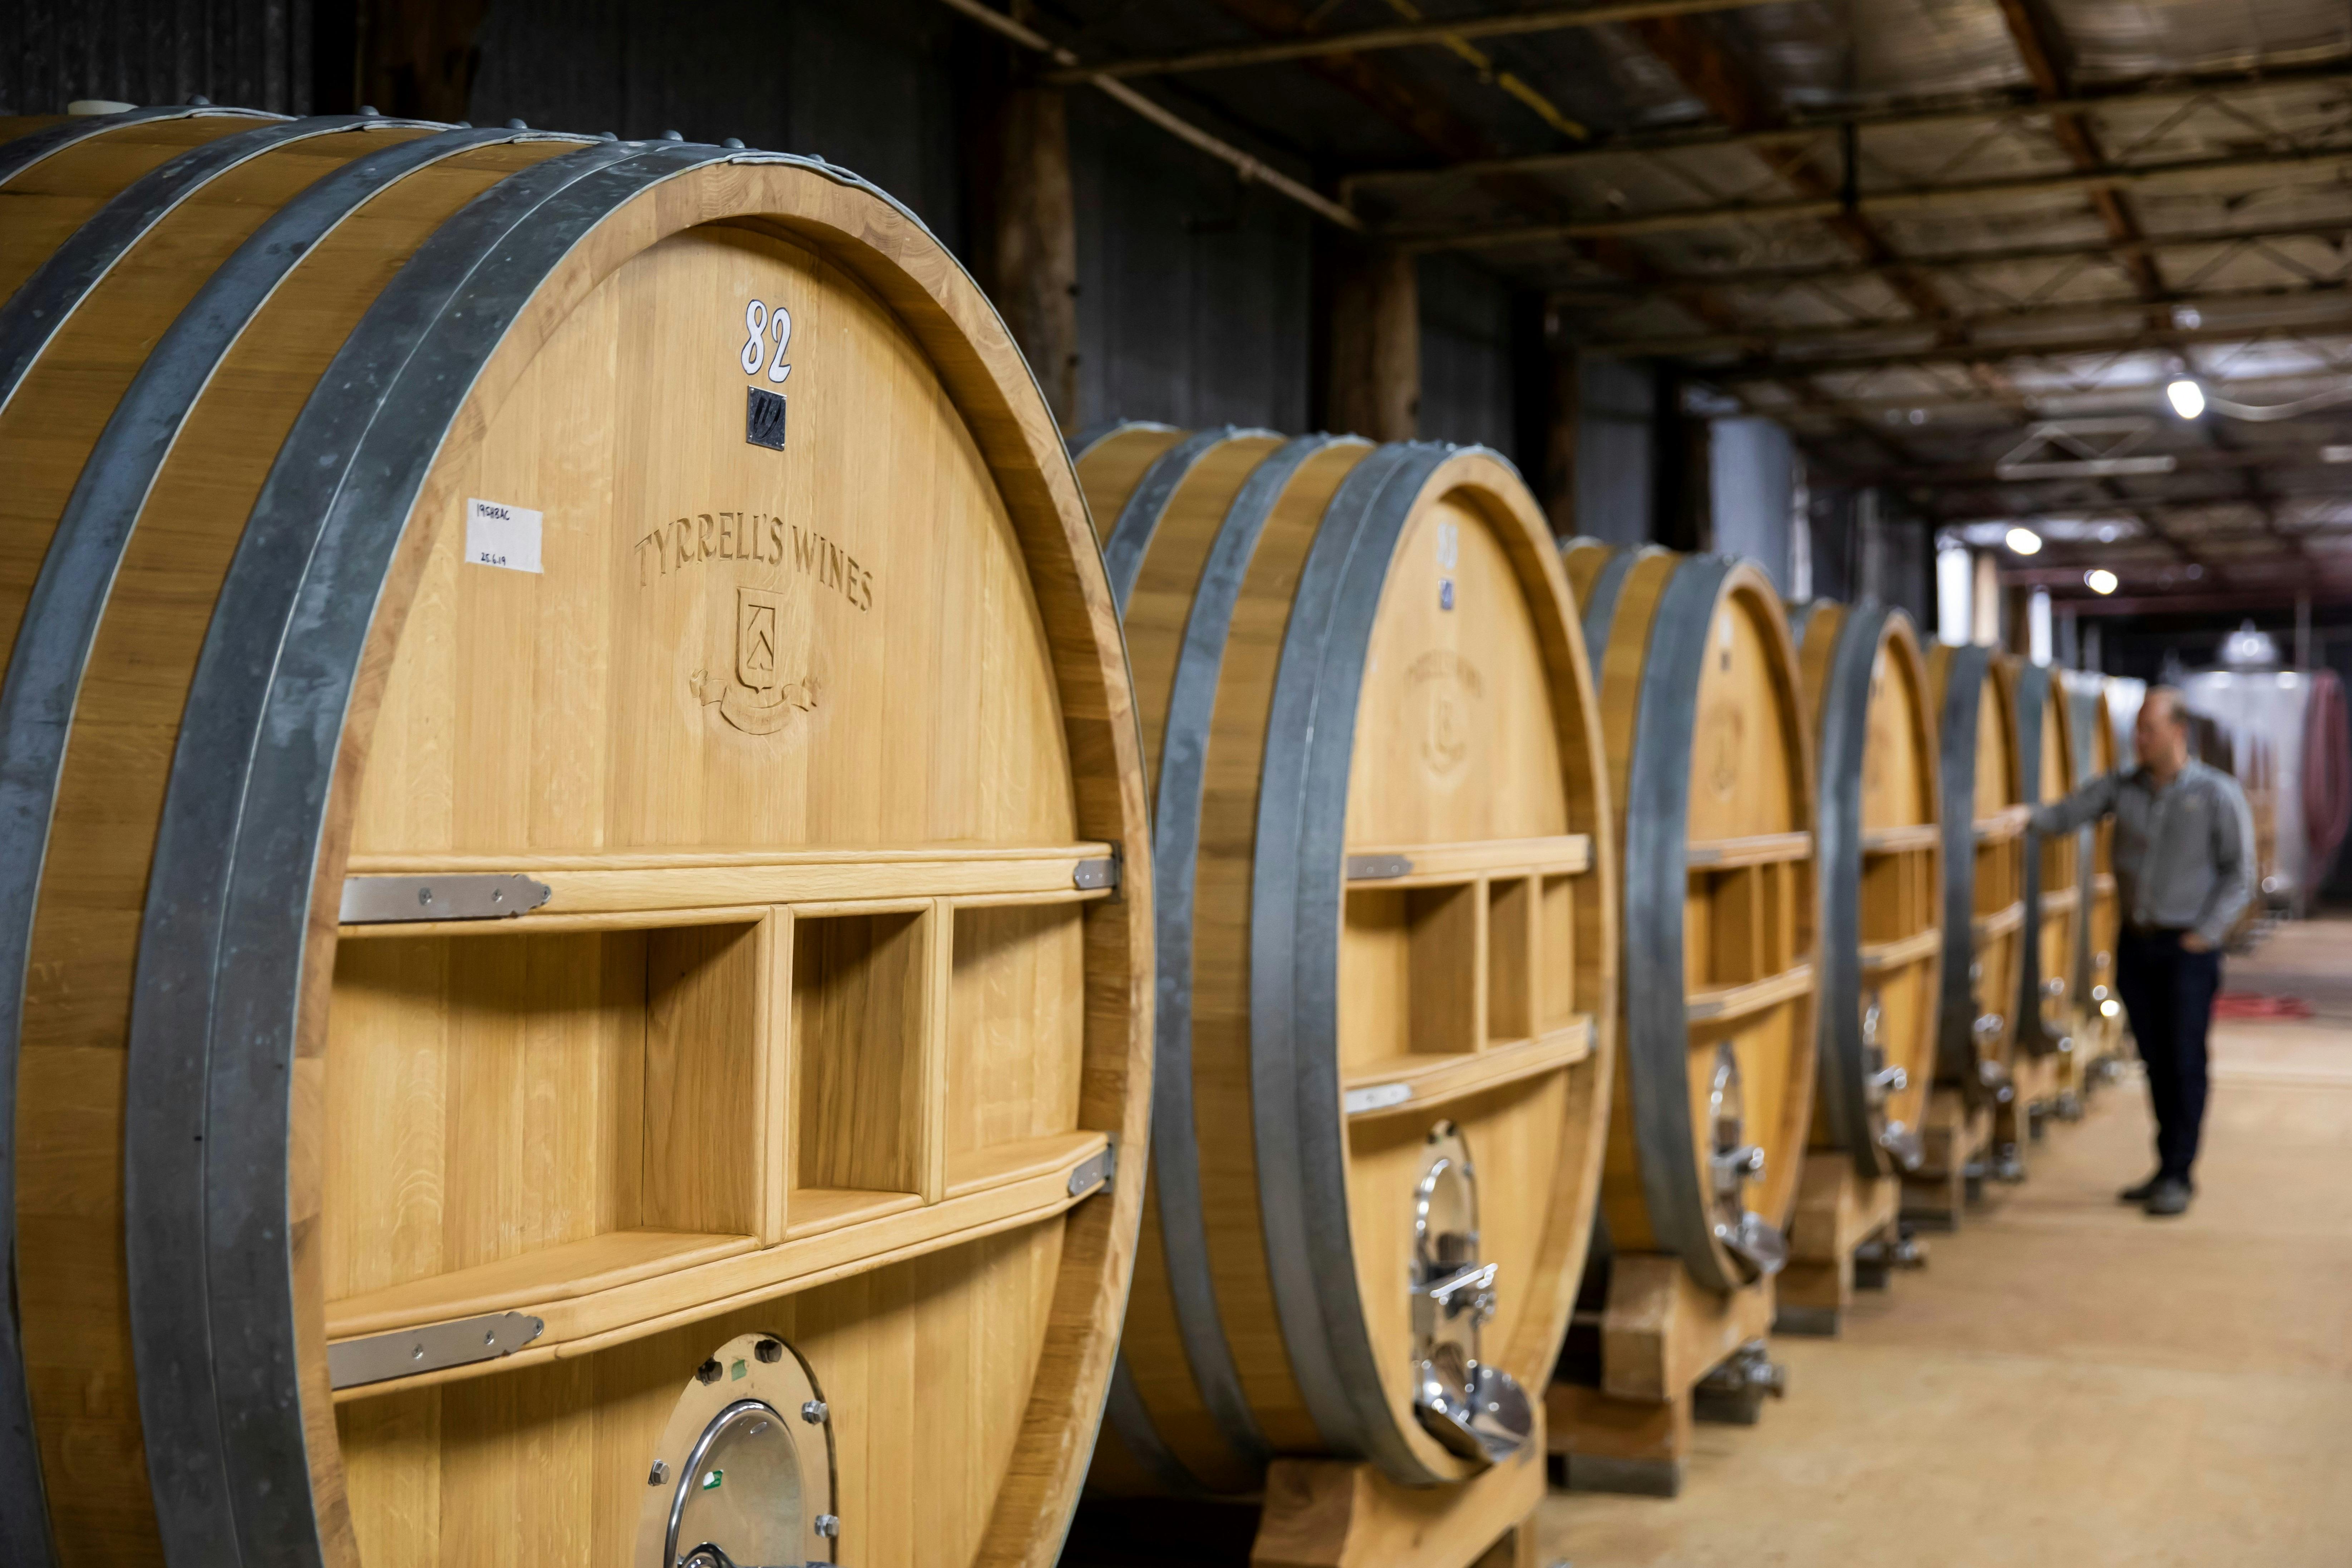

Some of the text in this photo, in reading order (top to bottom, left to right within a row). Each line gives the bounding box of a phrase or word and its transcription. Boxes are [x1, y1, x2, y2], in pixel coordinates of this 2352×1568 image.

[741, 299, 792, 383] 82
[634, 512, 873, 612] TYRRELL'S WINES
